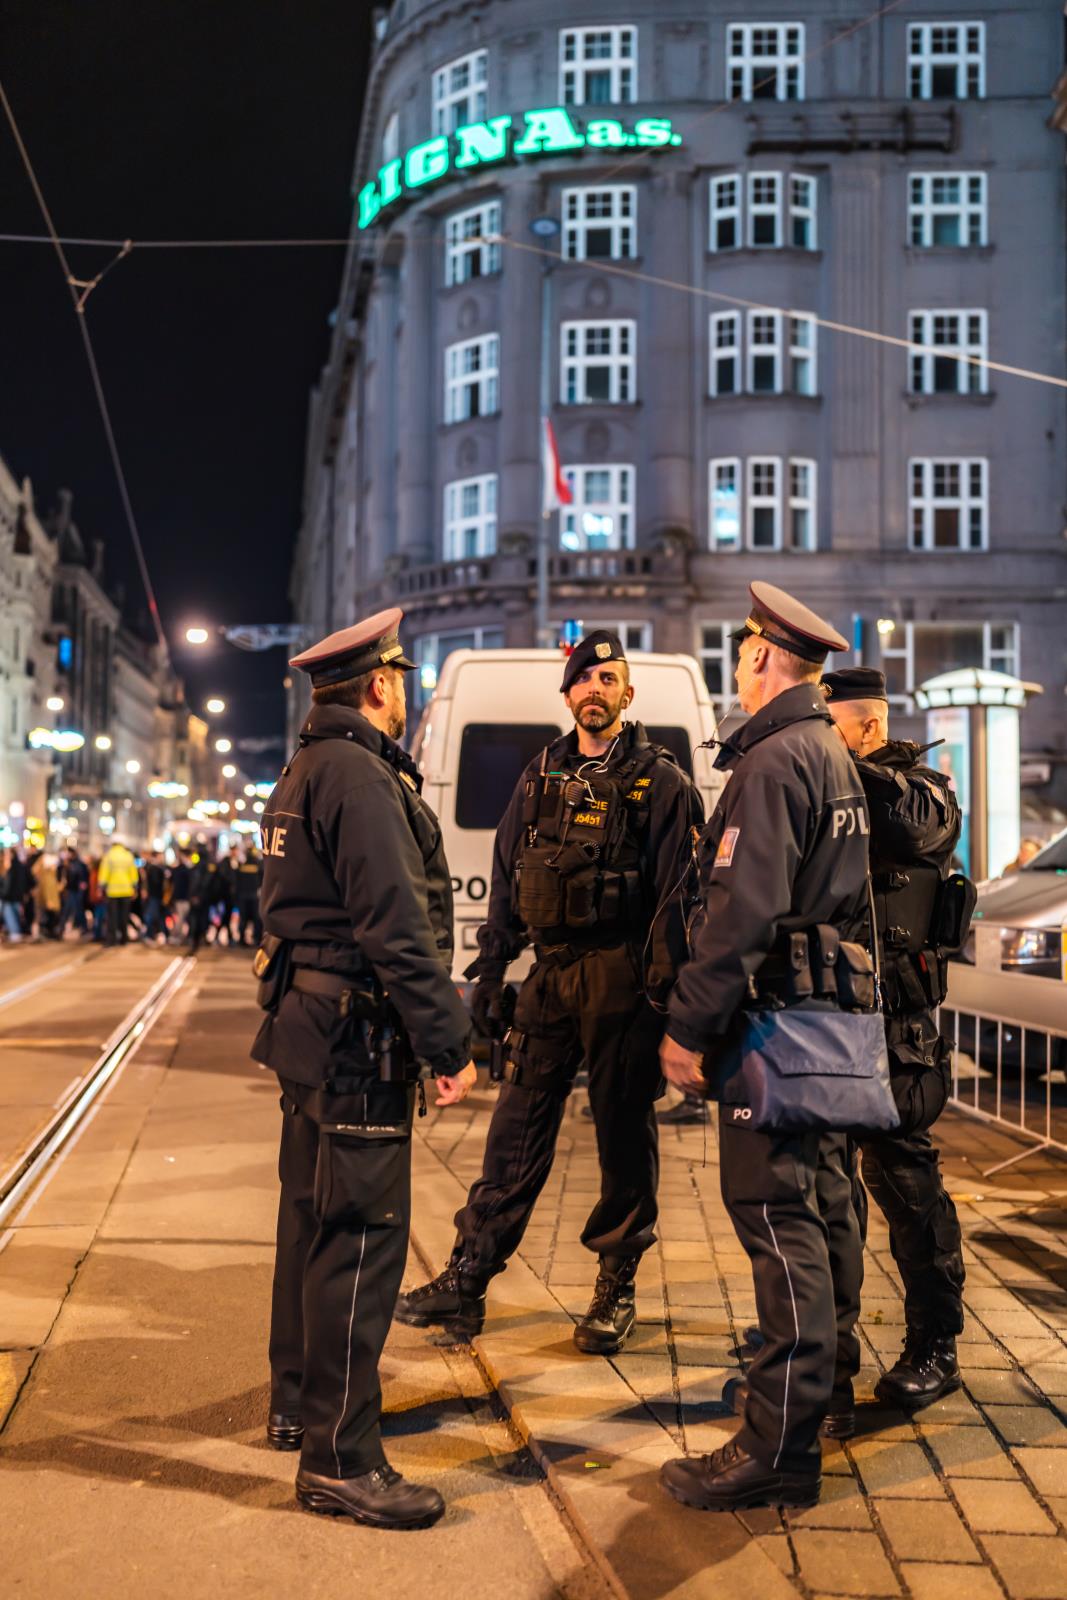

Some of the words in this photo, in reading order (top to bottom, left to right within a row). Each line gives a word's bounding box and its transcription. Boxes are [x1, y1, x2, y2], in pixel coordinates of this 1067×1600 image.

[357, 107, 585, 230] LIGNA
[586, 118, 682, 147] a.s.
[733, 1108, 752, 1120] PO
